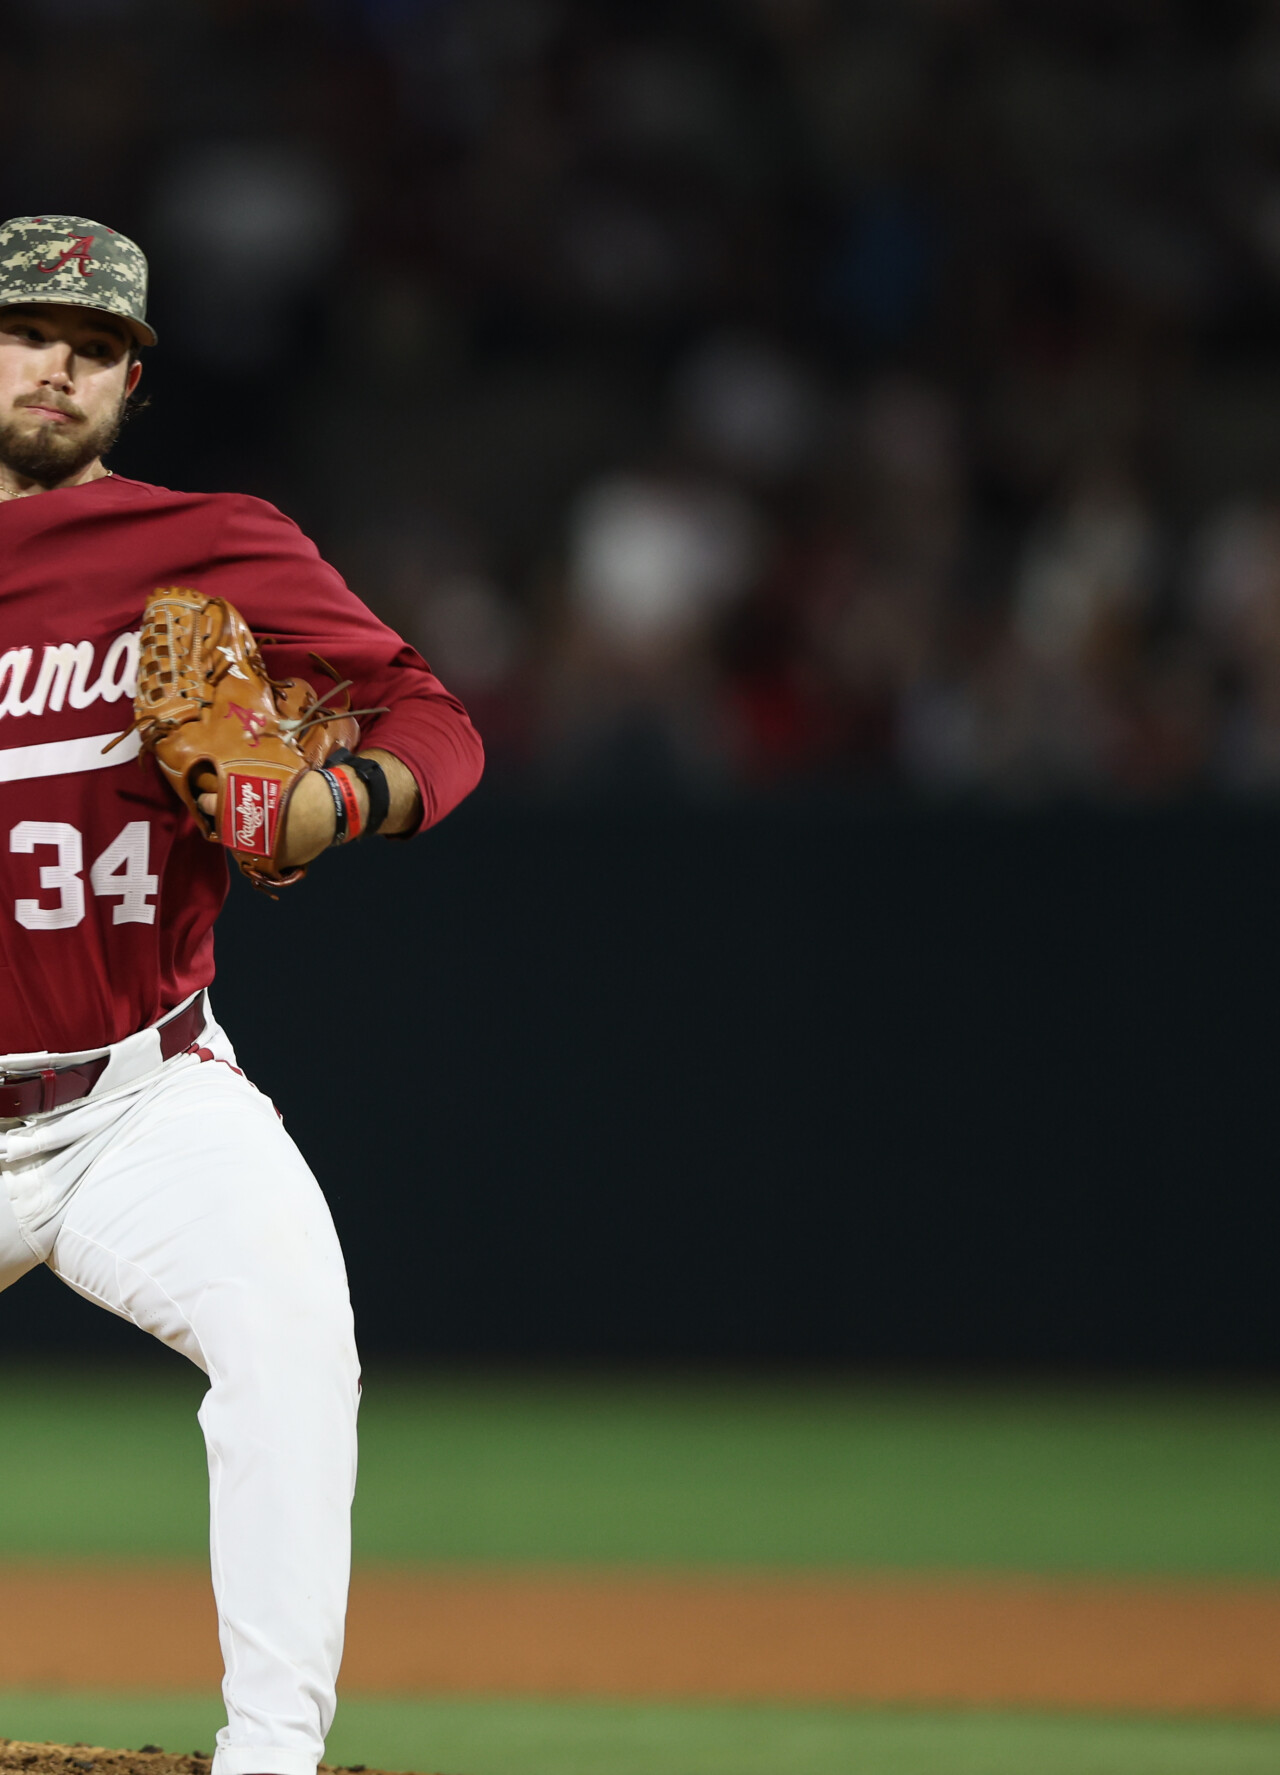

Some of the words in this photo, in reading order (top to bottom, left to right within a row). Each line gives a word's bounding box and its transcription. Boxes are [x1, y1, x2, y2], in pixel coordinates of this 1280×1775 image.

[37, 231, 95, 277] A
[235, 782, 263, 847] Rawlings
[9, 820, 159, 930] 34
